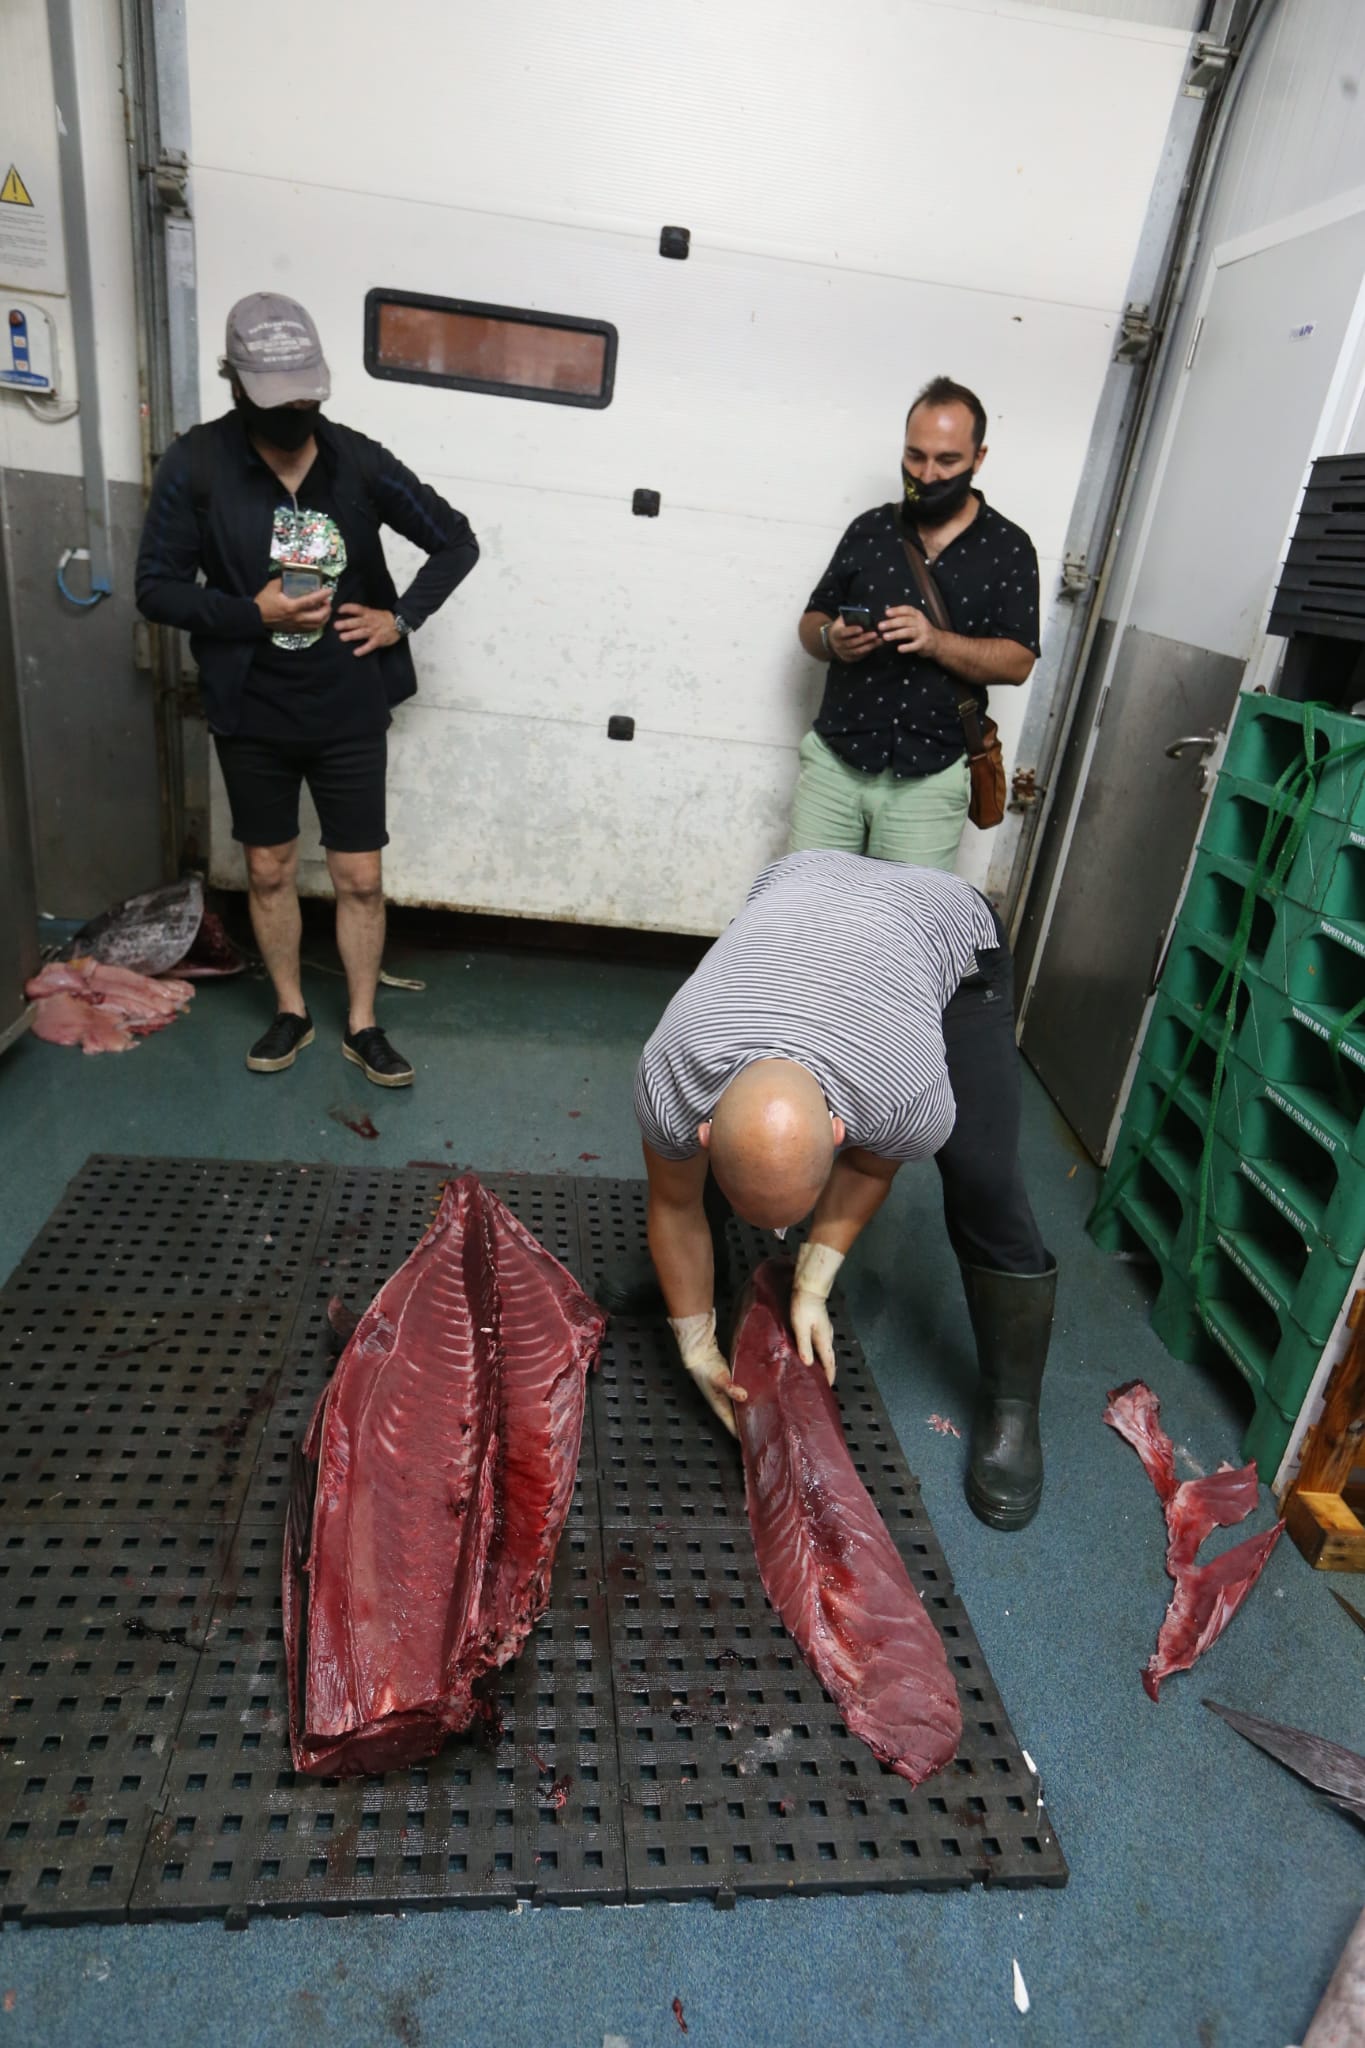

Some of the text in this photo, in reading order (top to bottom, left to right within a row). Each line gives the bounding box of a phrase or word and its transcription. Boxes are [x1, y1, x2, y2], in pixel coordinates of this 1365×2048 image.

[1265, 1085, 1337, 1151] PROPERTY OF POOLING PARTNERS
[1240, 1160, 1307, 1232] PROPERTY OF POOLING PARTNERS
[1217, 1234, 1237, 1258] PROPERTY
[1235, 1256, 1243, 1265] OF
[1258, 1282, 1280, 1311] PARTNERS
